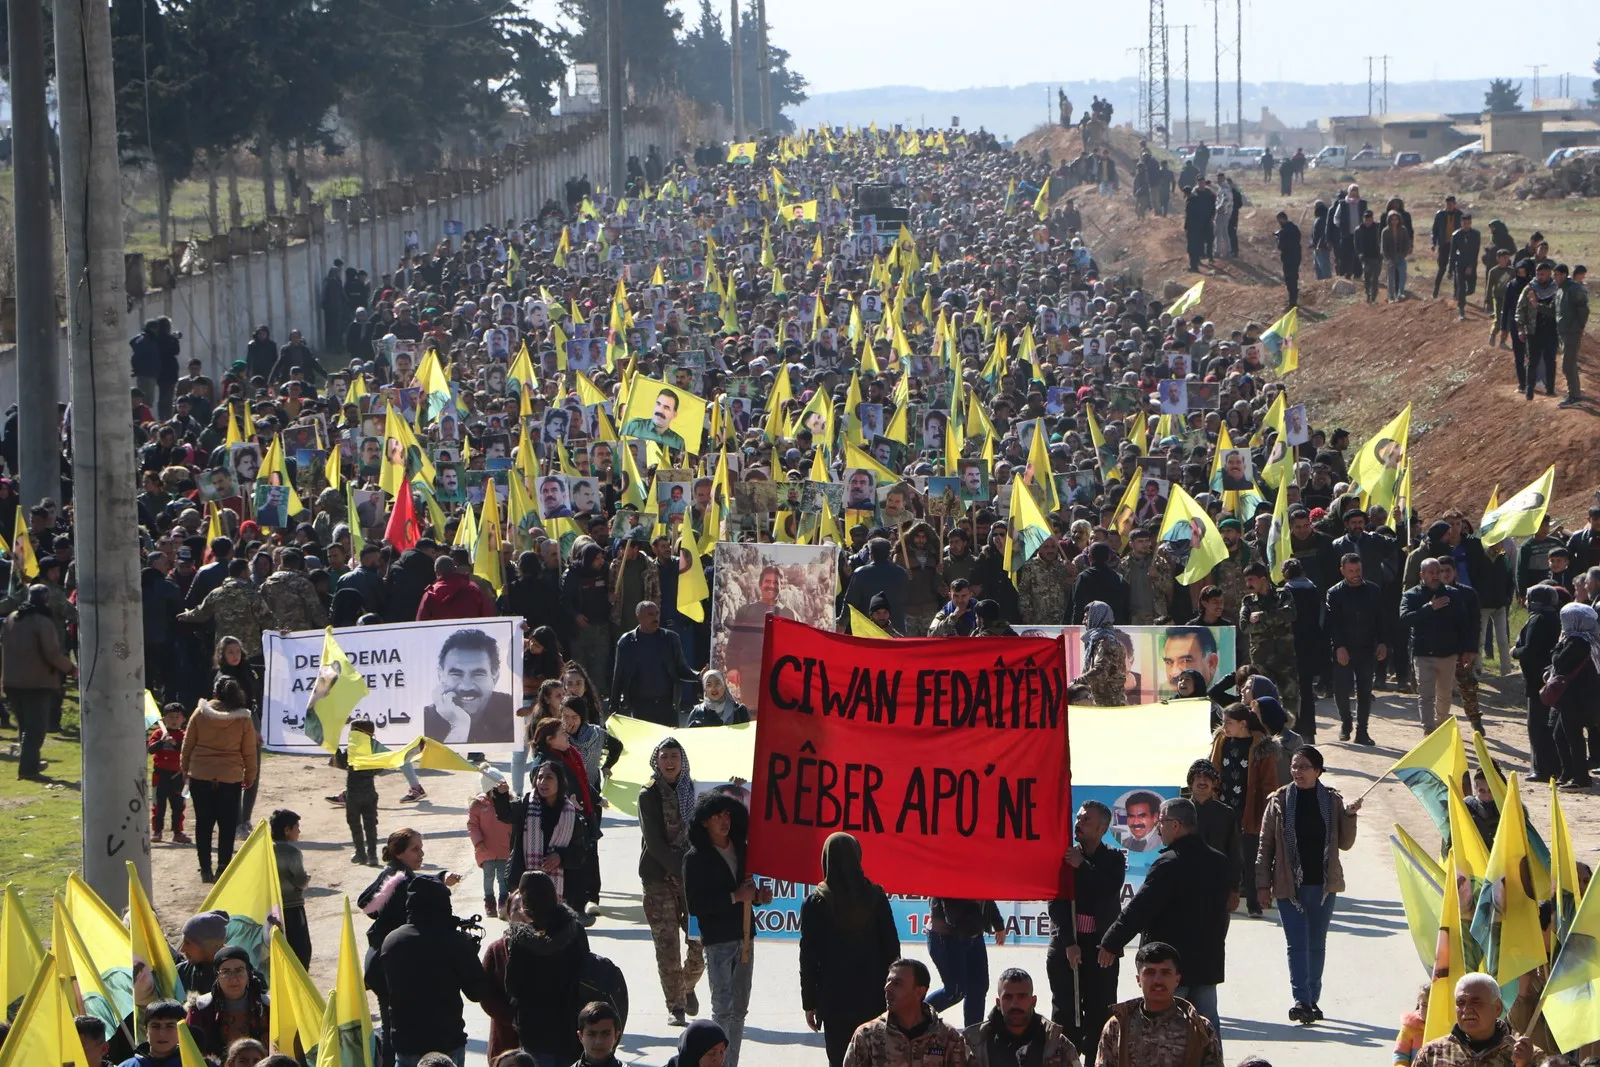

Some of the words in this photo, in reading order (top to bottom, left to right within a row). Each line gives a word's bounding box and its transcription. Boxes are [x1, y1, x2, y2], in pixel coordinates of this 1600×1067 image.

[295, 655, 319, 669] DE
[382, 669, 405, 687] YÊ
[769, 654, 902, 724] CIWAN
[764, 741, 884, 834] RÊBER
